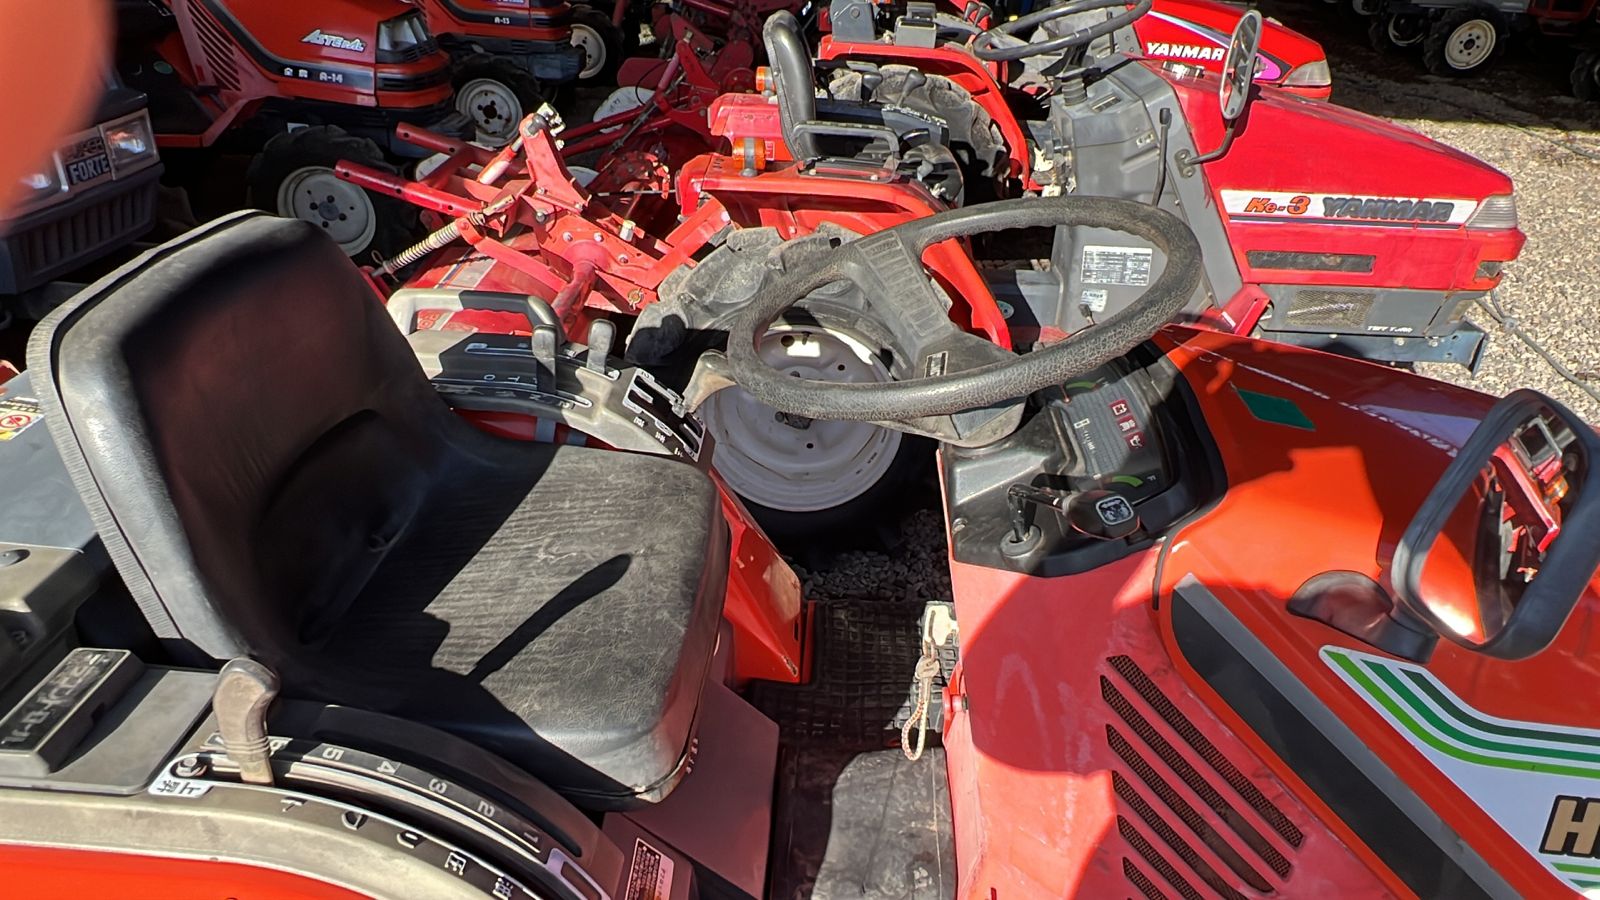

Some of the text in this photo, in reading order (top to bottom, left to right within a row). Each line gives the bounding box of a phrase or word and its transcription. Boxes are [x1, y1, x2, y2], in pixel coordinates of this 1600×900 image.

[1146, 42, 1226, 61] YANMAR
[319, 71, 344, 84] A-14
[68, 154, 110, 185] FORTE
[1244, 195, 1455, 223] Ke-3 YANMAR
[321, 747, 344, 761] 5
[376, 761, 397, 775] 4
[428, 778, 447, 794] 3
[477, 800, 496, 818] 2
[1539, 795, 1600, 859] H
